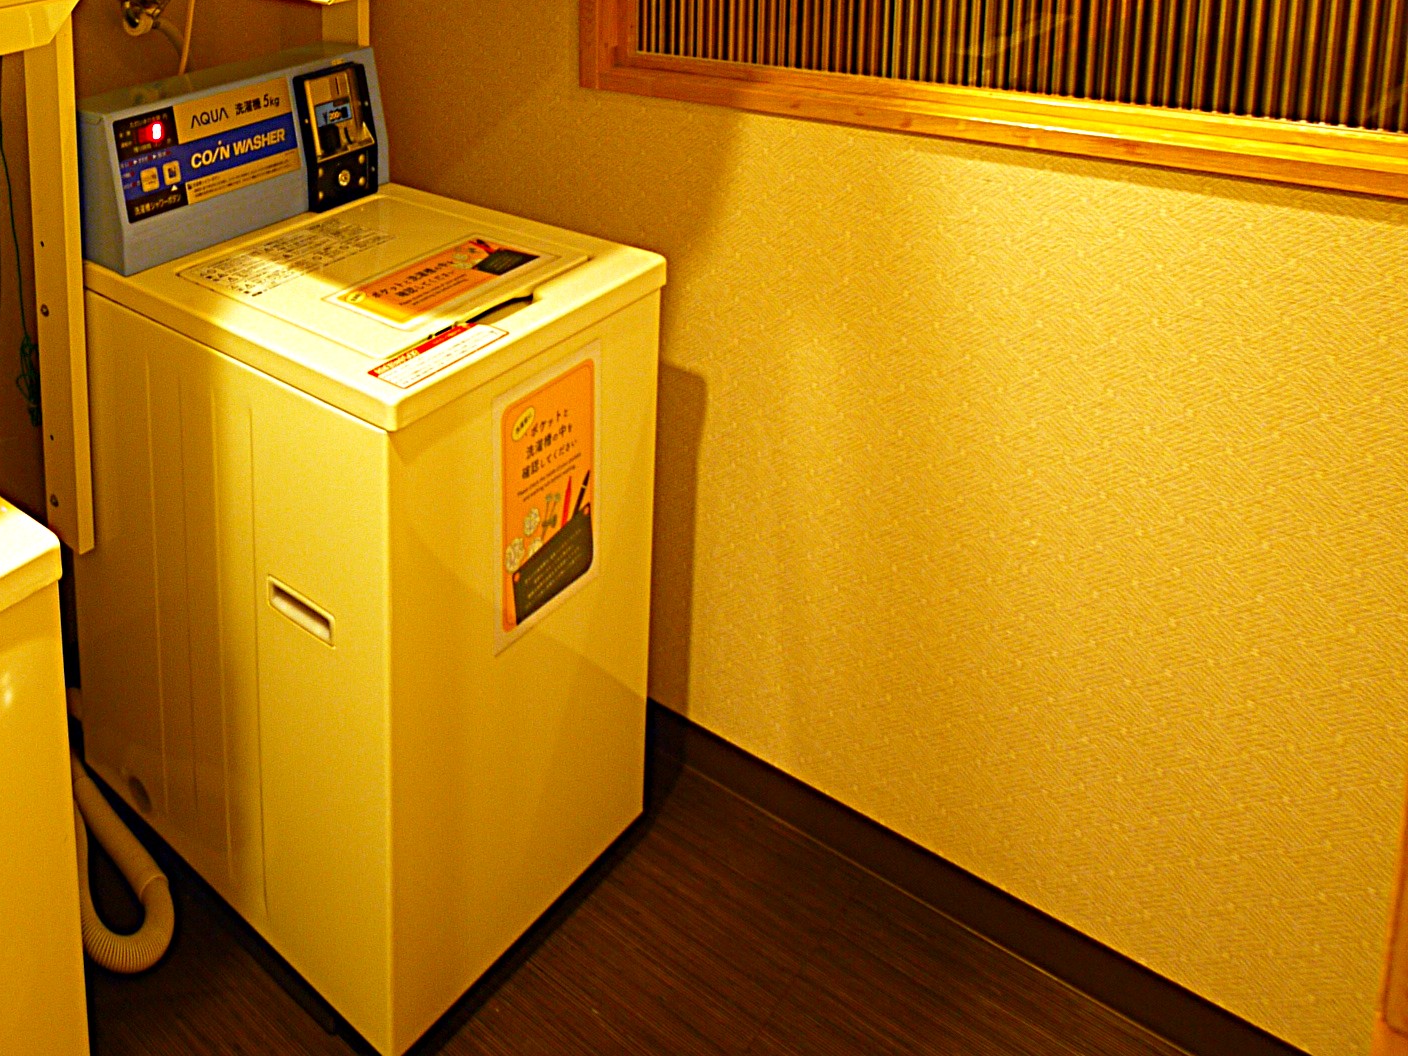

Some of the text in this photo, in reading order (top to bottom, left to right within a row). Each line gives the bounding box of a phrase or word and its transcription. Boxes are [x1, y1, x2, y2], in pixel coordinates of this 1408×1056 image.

[263, 93, 280, 108] 5kg
[191, 107, 229, 129] AQUA
[233, 128, 286, 156] WASHER
